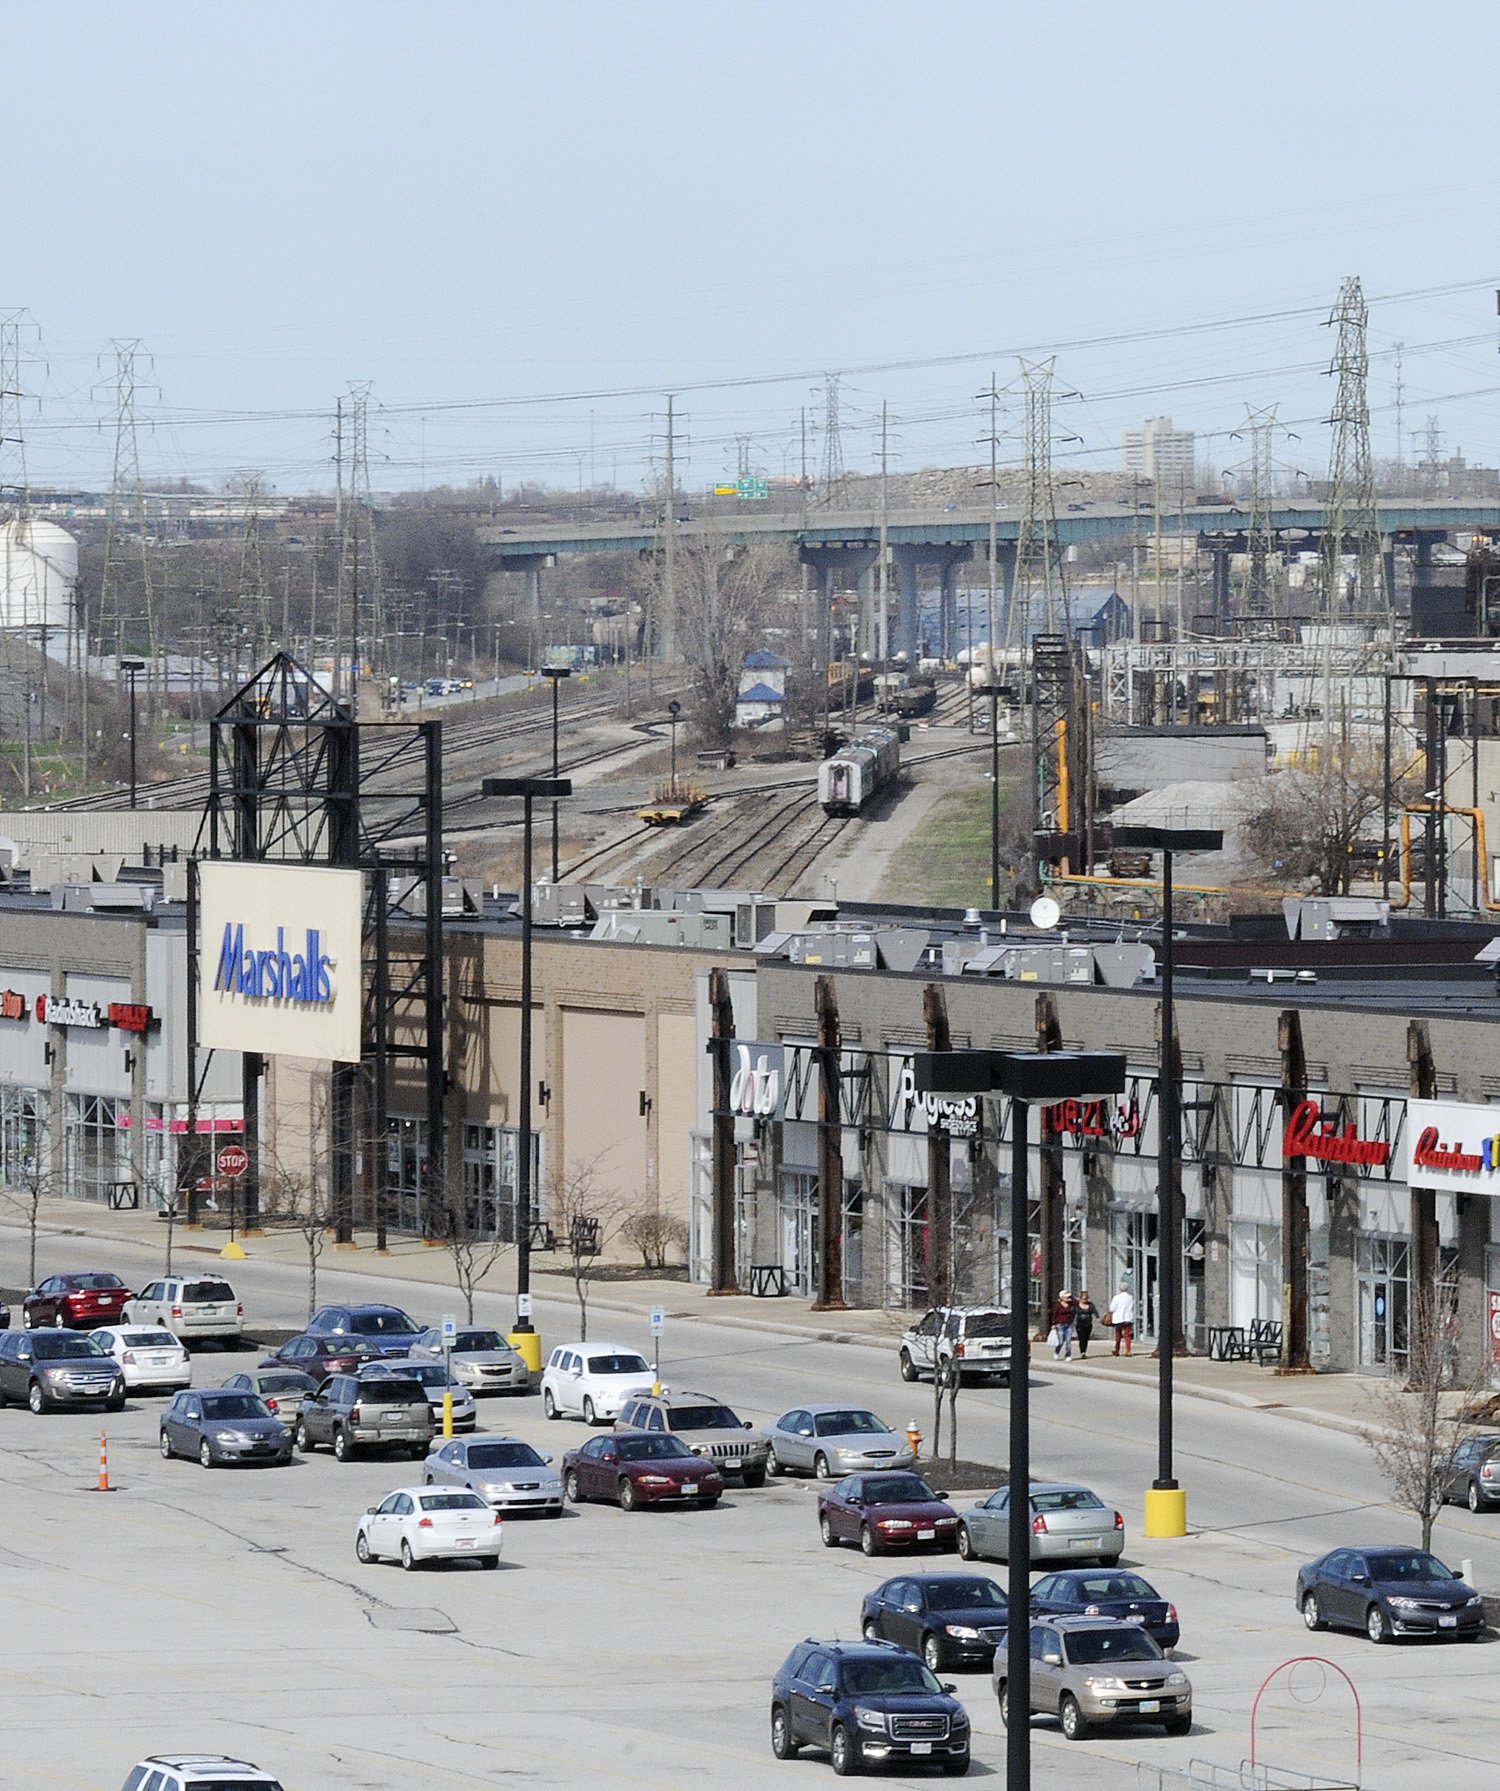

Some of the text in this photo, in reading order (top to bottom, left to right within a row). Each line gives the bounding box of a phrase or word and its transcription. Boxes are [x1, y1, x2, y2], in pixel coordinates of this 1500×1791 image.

[213, 922, 330, 1004] Marshalls
[46, 998, 100, 1028] RadioShack
[730, 1044, 778, 1115] dots
[1283, 1101, 1390, 1165] Rainbow
[1414, 1127, 1484, 1171] Rainbow
[219, 1155, 245, 1167] STOP
